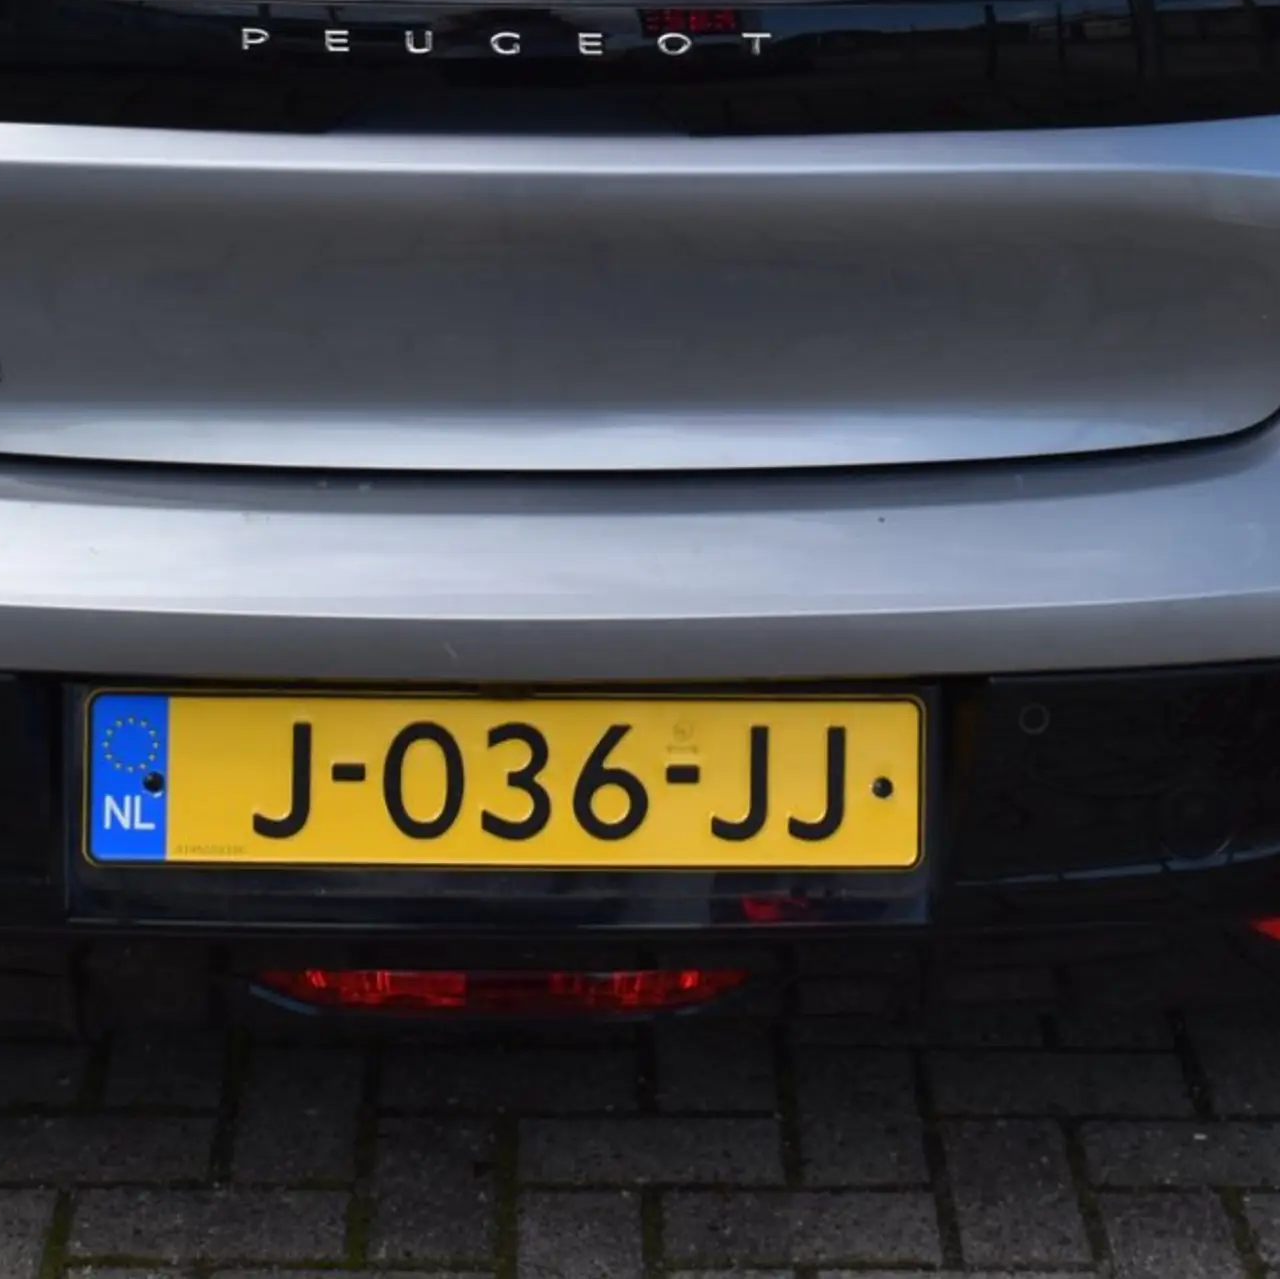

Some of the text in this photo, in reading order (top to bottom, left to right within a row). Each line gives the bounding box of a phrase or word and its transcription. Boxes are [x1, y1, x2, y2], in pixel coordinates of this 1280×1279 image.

[240, 27, 773, 56] PEUGEOT
[251, 721, 847, 841] J-036-JJ
[103, 795, 156, 832] NL
